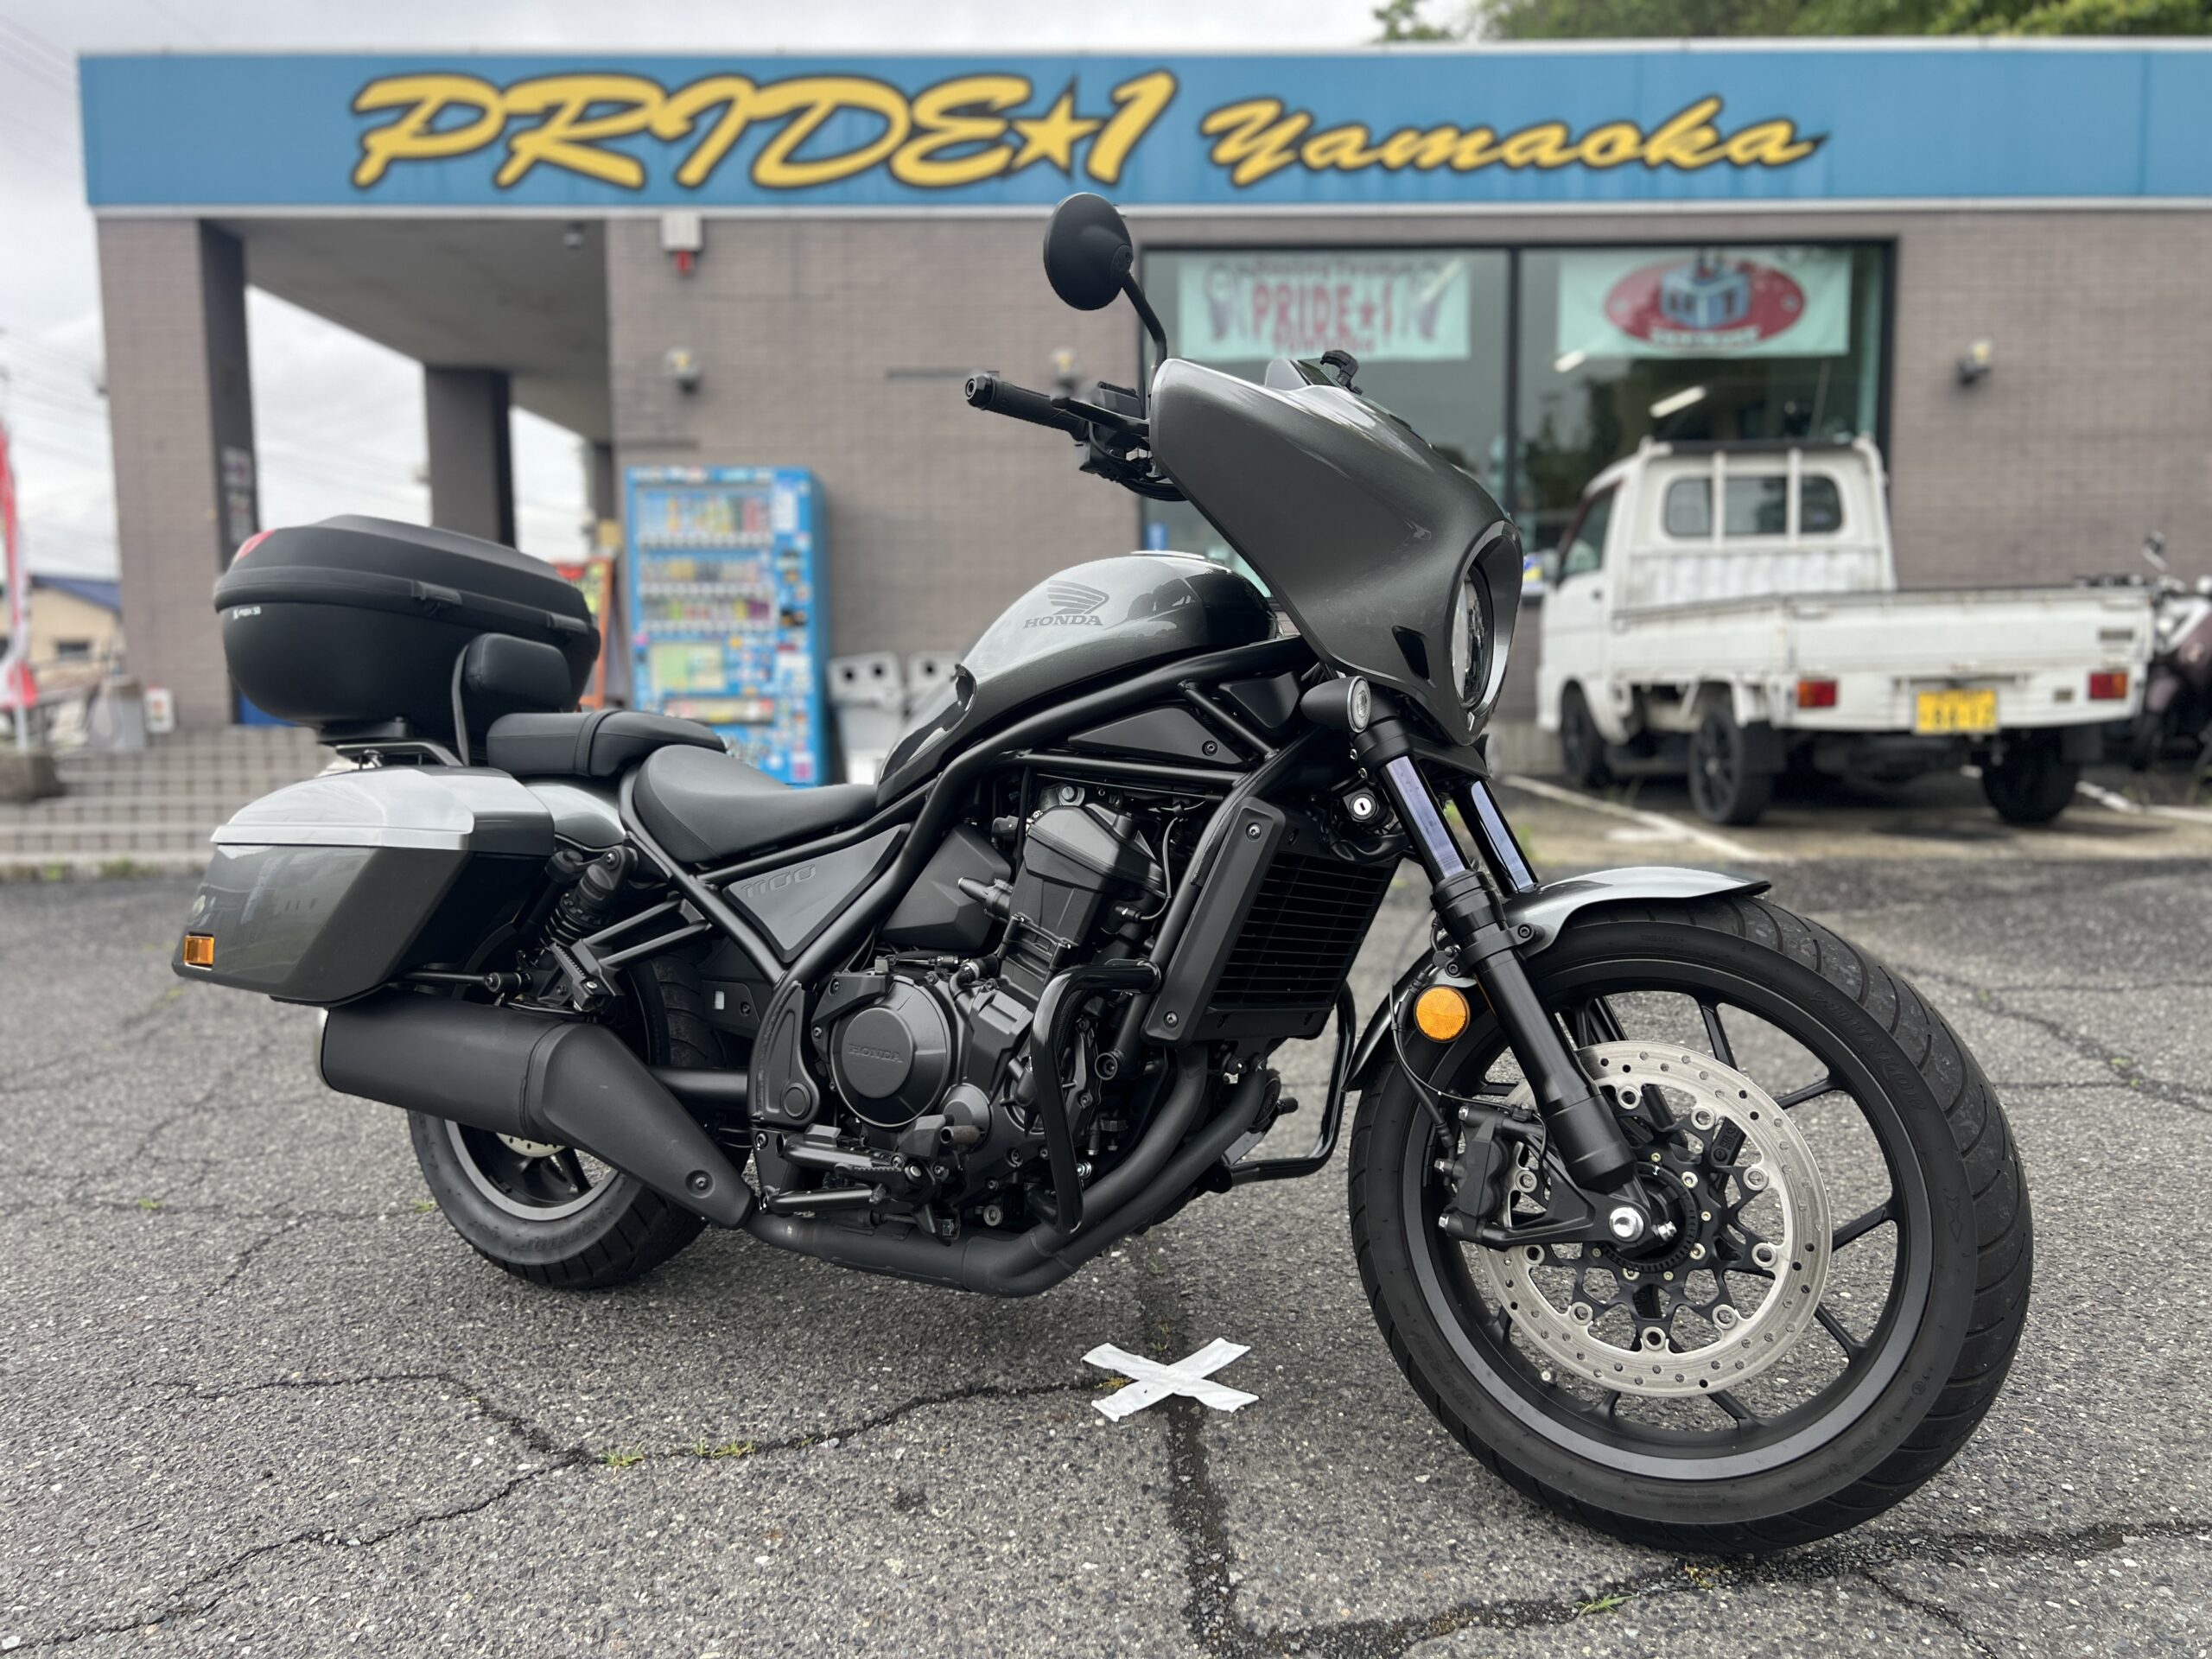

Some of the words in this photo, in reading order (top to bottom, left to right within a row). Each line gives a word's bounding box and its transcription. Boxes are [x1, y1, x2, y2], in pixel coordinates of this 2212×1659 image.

[1198, 95, 1829, 188] Yamaoka
[1022, 613, 1103, 630] HONDA
[741, 864, 817, 899] 1100
[848, 1043, 905, 1064] HONDA
